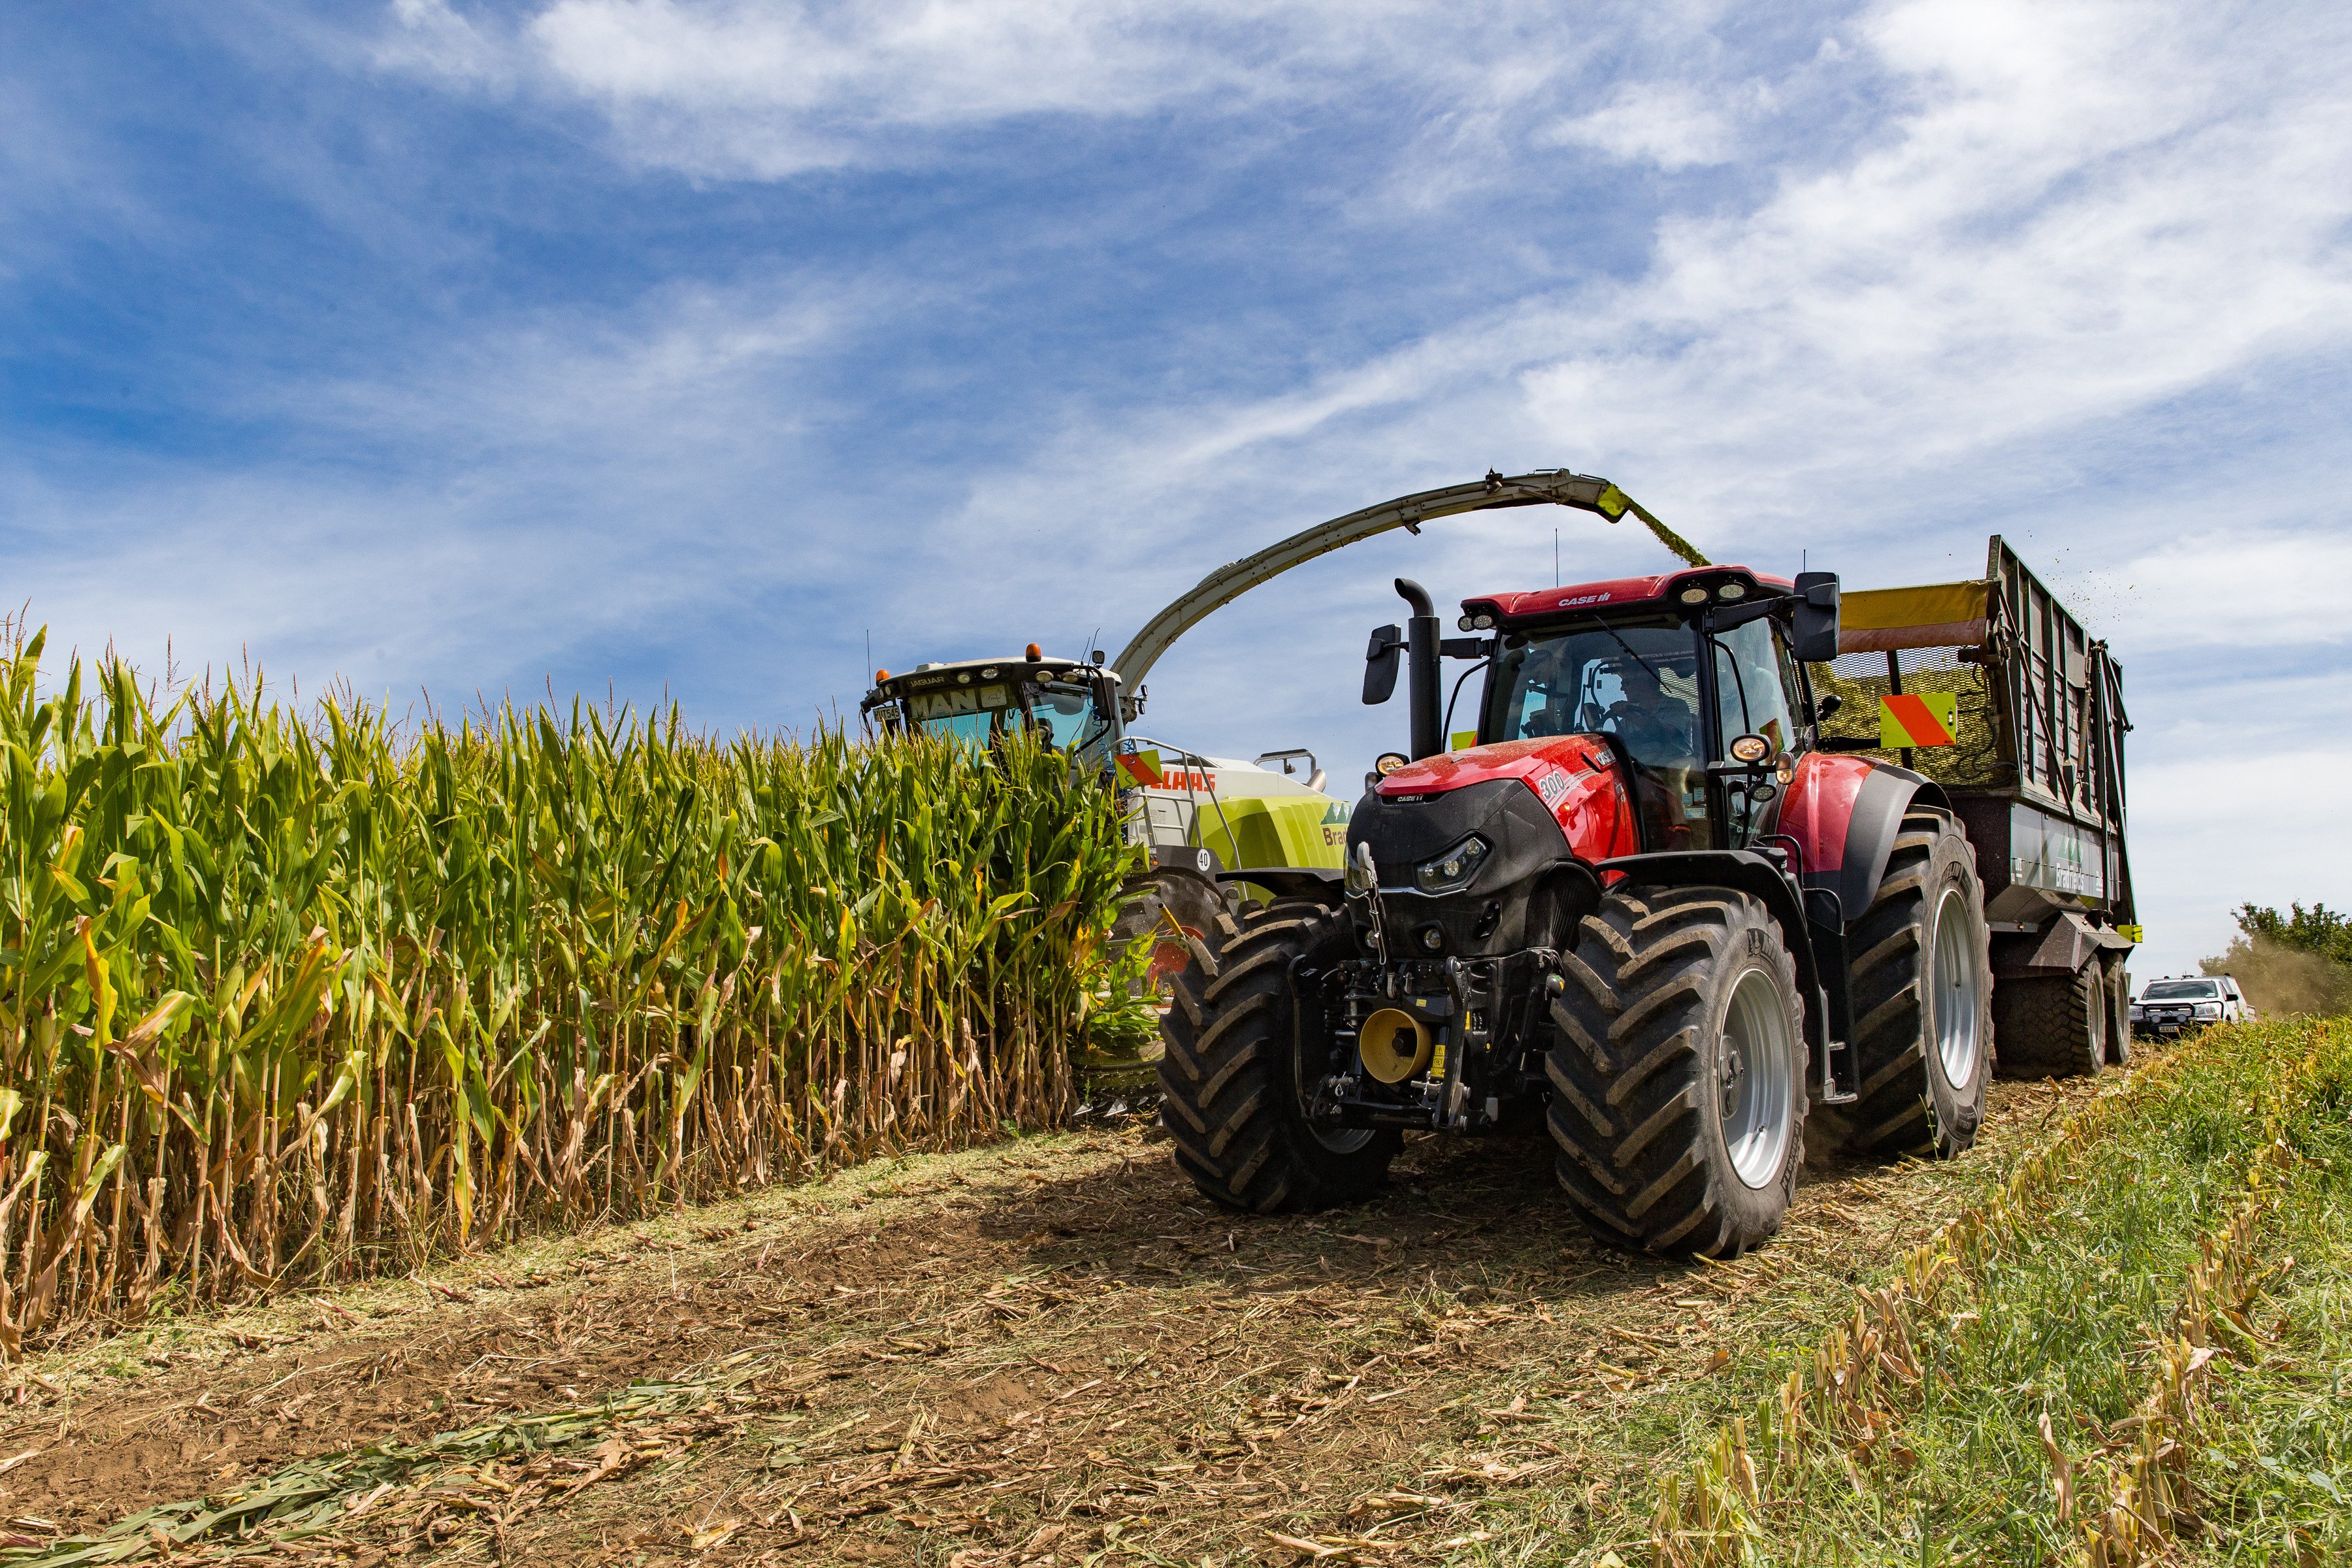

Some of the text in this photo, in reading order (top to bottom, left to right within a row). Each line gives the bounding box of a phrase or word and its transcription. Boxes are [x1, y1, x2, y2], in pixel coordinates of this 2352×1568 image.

[1558, 595, 1597, 606] CASE
[911, 676, 945, 687] JAGUAR
[908, 689, 978, 718] MAN
[1539, 771, 1565, 800] 300
[1199, 853, 1209, 867] 40
